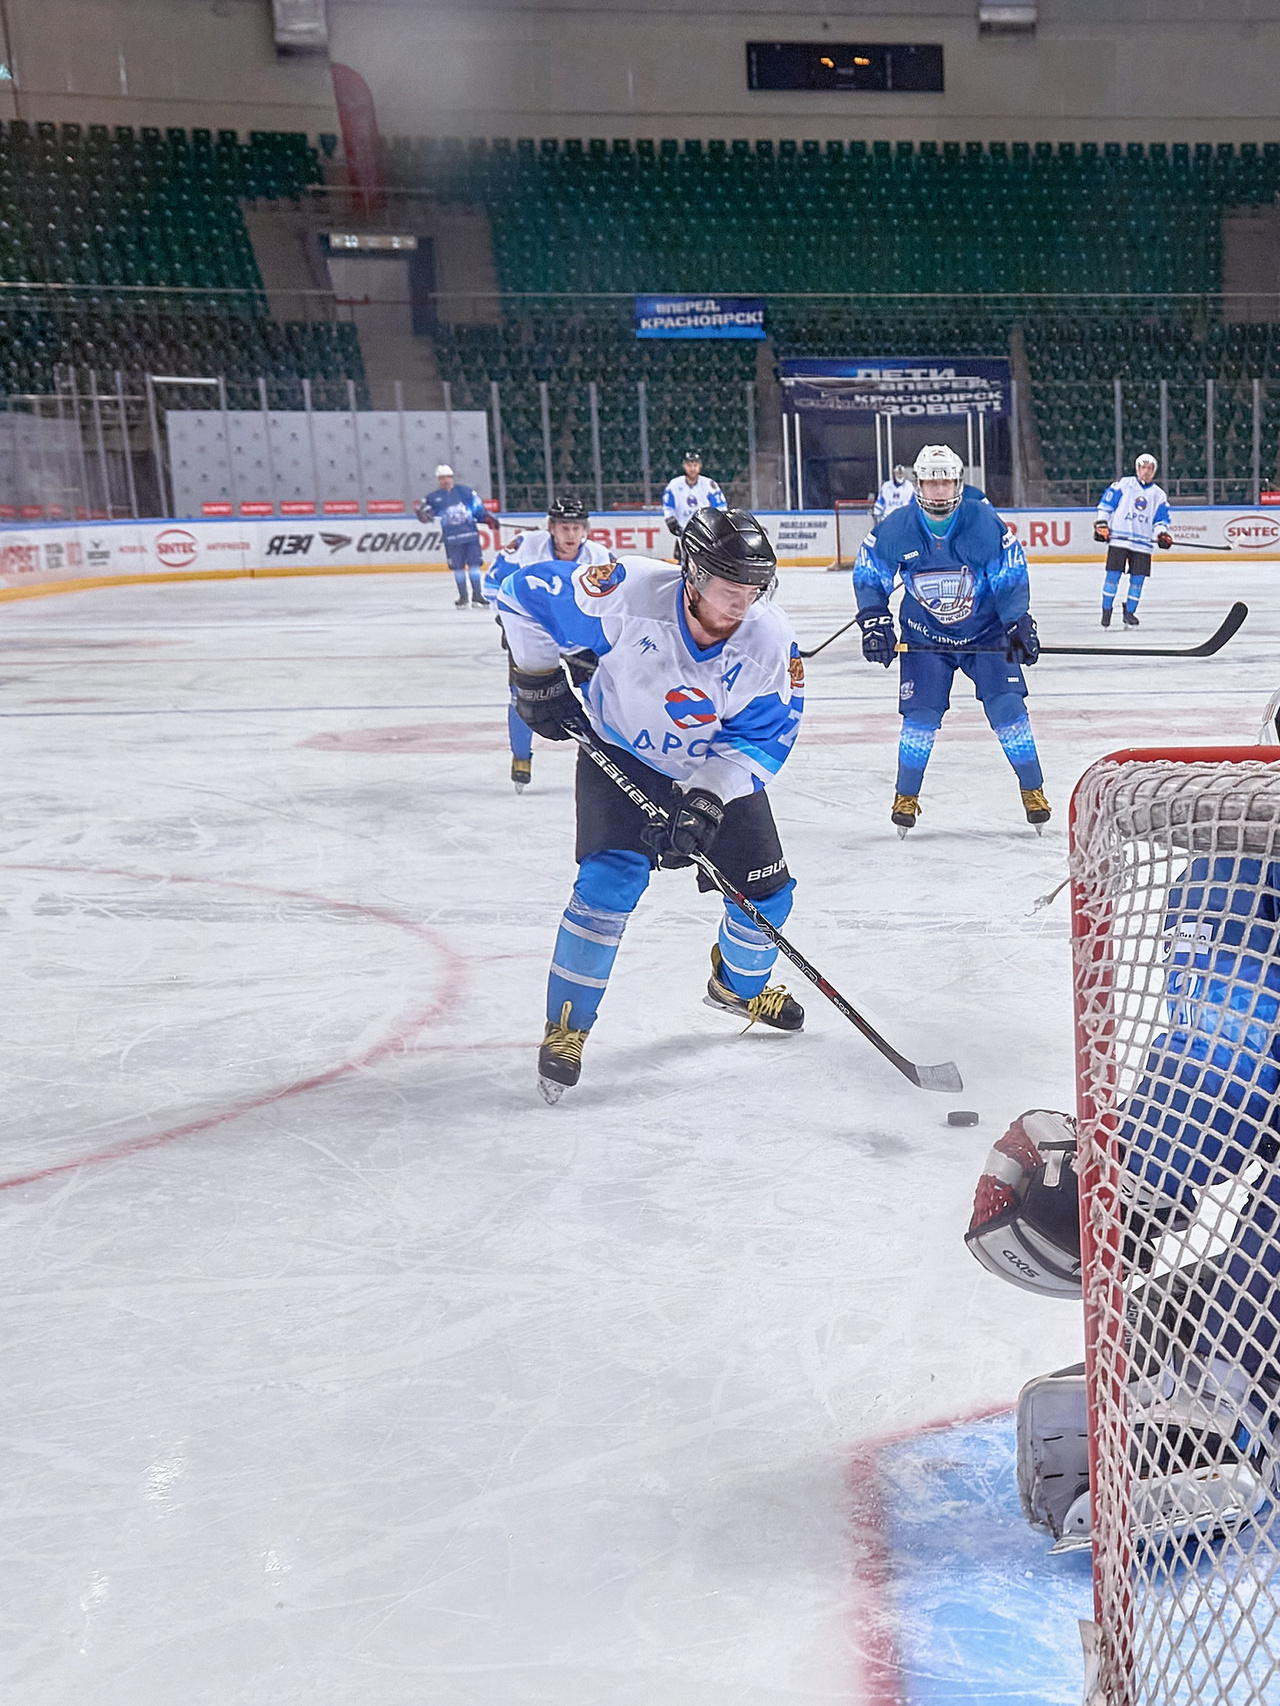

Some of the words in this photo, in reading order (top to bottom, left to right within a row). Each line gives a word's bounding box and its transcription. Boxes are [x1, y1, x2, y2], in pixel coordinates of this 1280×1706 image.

[640, 311, 763, 329] КРАСНОЯРСК!
[1227, 526, 1279, 538] SINTEC
[1007, 544, 1025, 569] 14
[720, 661, 743, 692] A
[589, 750, 670, 820] BAUER
